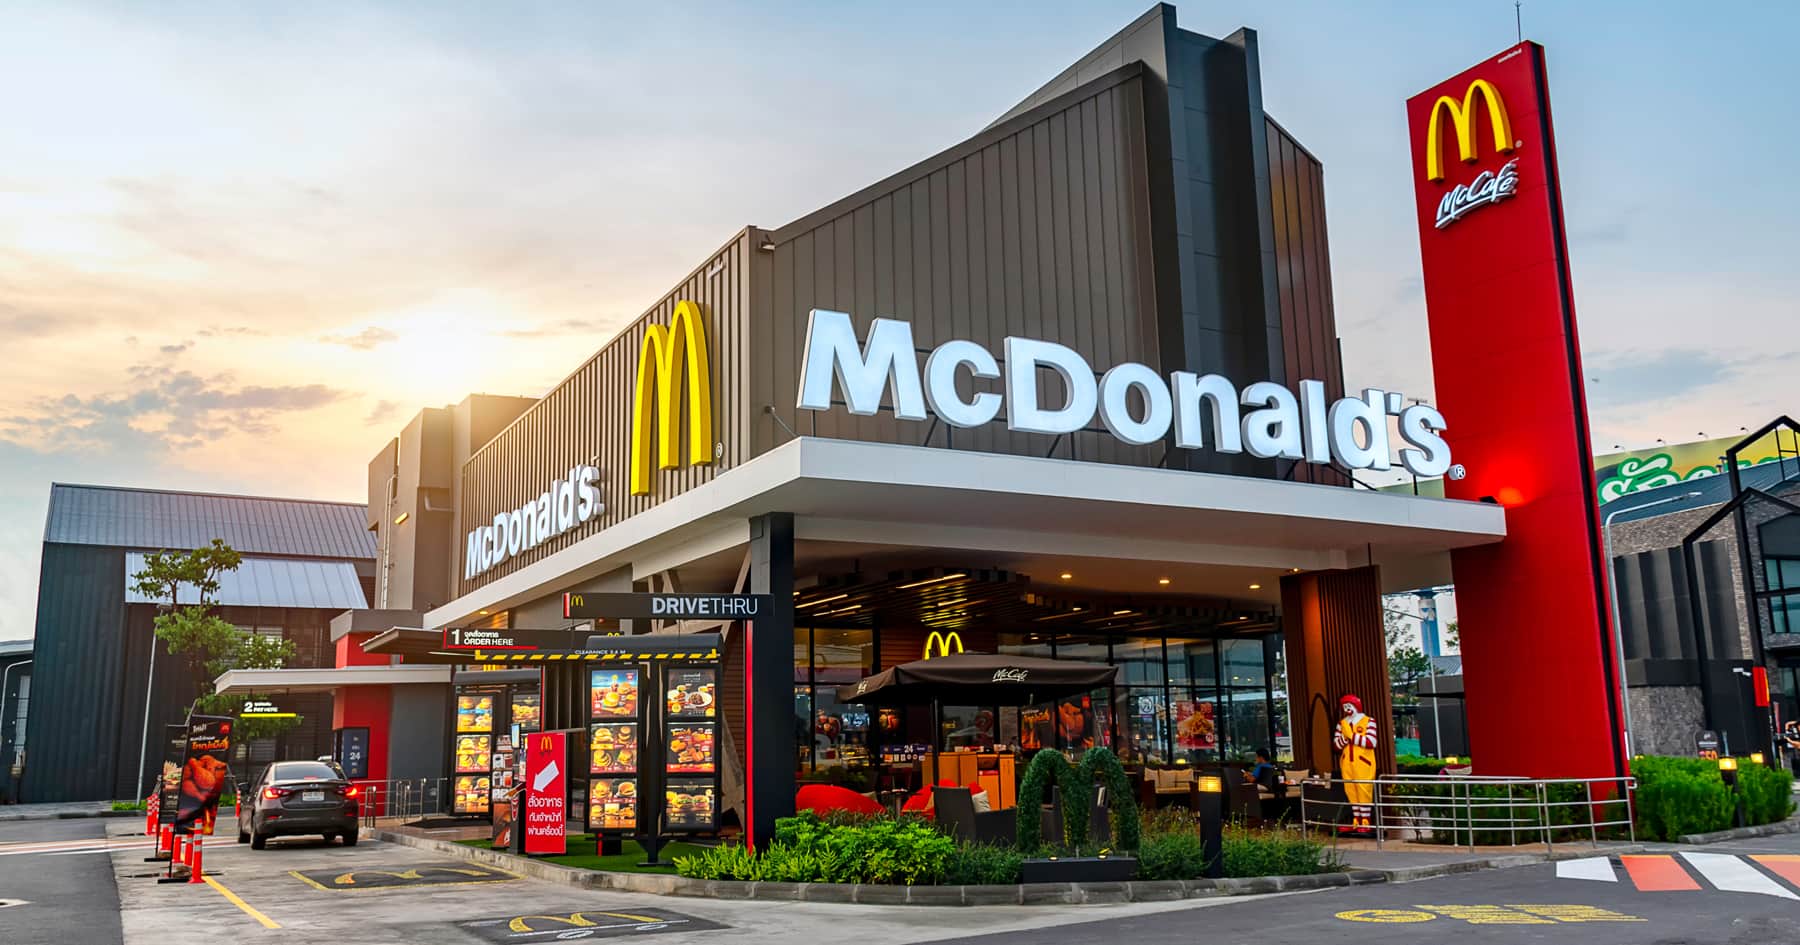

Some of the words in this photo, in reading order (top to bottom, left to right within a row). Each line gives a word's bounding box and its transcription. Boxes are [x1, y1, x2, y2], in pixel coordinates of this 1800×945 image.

[1435, 157, 1520, 228] McCafé
[796, 308, 1452, 479] McDonald's
[465, 464, 602, 580] McDonald's
[451, 628, 460, 645] 1
[463, 638, 491, 646] ORDER
[491, 638, 514, 646] HERE
[243, 701, 253, 713] 2
[528, 792, 562, 808] สั่งอาหาร
